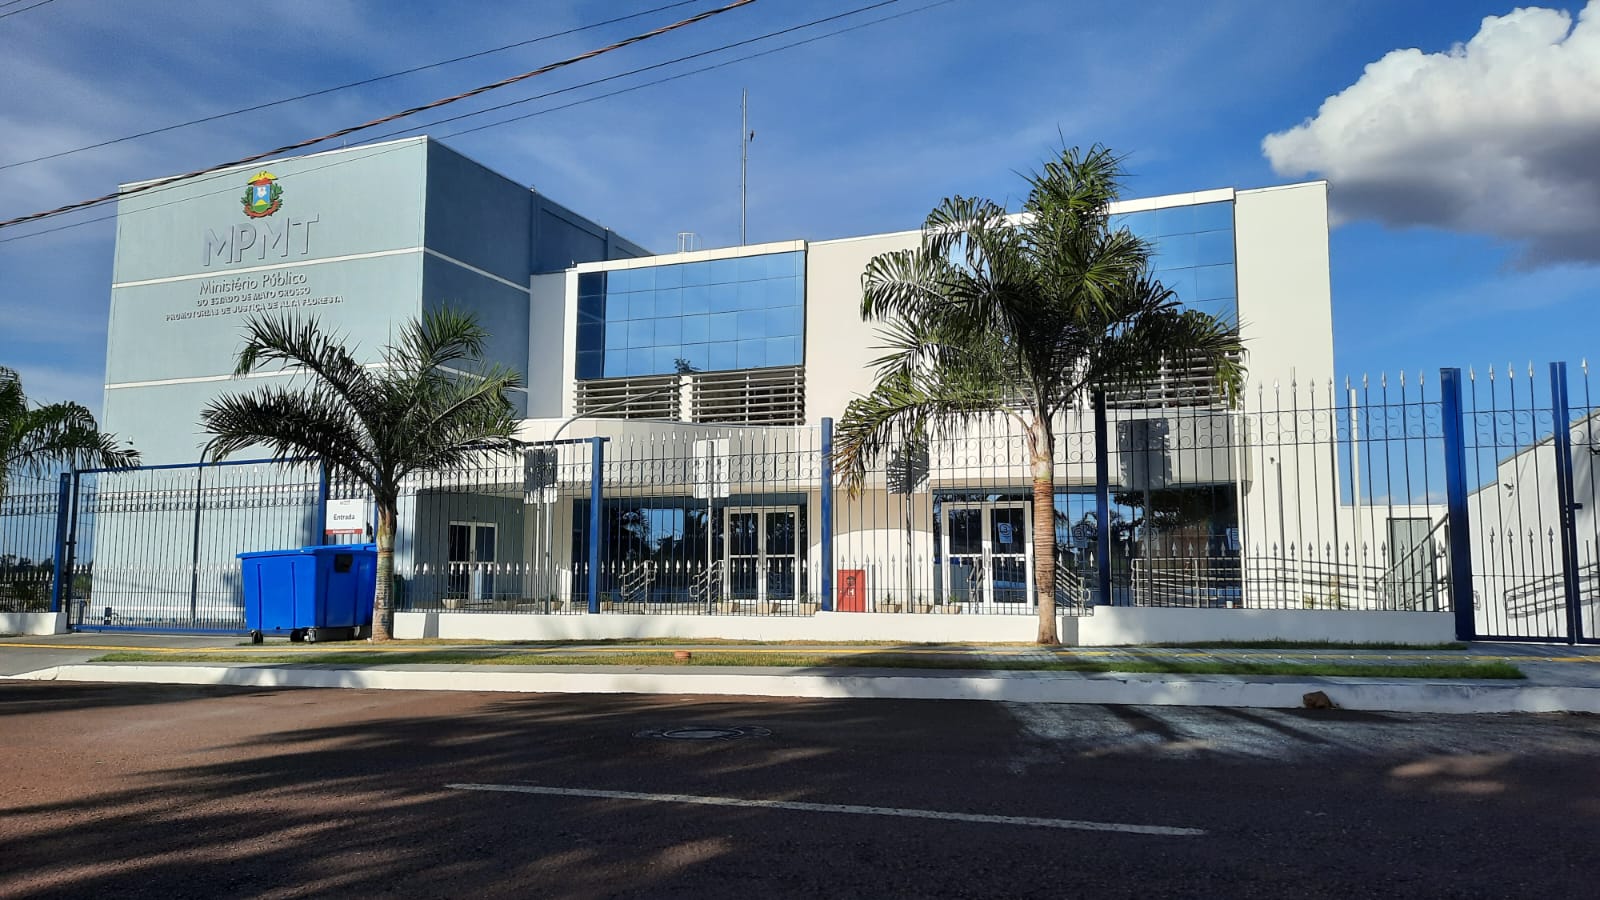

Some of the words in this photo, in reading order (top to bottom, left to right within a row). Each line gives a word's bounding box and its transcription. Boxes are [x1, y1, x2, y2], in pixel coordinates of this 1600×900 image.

[203, 212, 319, 266] MPMT
[200, 277, 258, 295] Ministério
[263, 271, 307, 288] Público
[211, 295, 240, 305] ESTADO
[241, 293, 252, 302] DE
[253, 290, 276, 301] MATO
[278, 286, 311, 298] GROSSO
[166, 308, 219, 321] PROMOTORIAS
[221, 307, 231, 315] DE
[267, 301, 279, 310] DE
[302, 295, 344, 306] FLORESTA
[333, 513, 355, 521] Entrada
